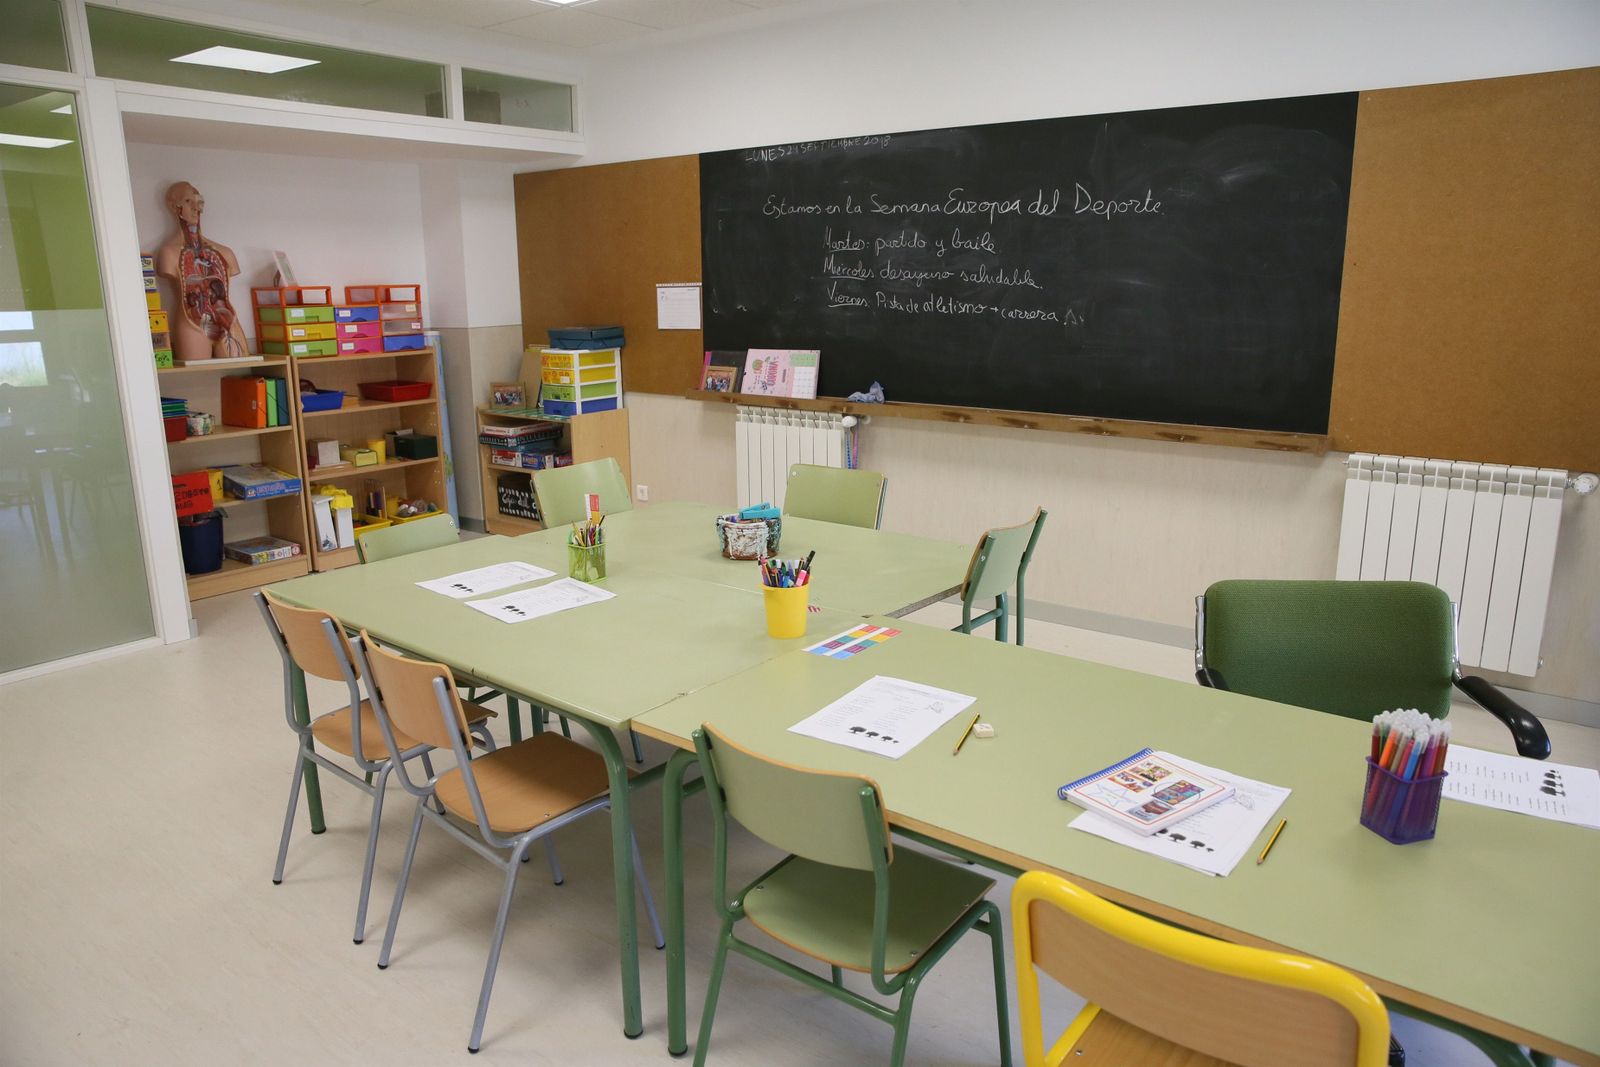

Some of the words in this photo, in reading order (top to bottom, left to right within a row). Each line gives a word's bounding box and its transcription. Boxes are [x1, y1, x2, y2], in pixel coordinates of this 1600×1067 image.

[744, 147, 785, 162] LUNES
[863, 135, 891, 149] 2018
[763, 194, 821, 219] Estamos
[825, 204, 841, 214] en
[846, 195, 862, 214] la
[870, 193, 941, 215] Semana
[943, 188, 1022, 224] Europea
[1027, 188, 1060, 216] del
[935, 240, 947, 257] y
[952, 227, 997, 255] baile
[880, 260, 955, 287] desayuno
